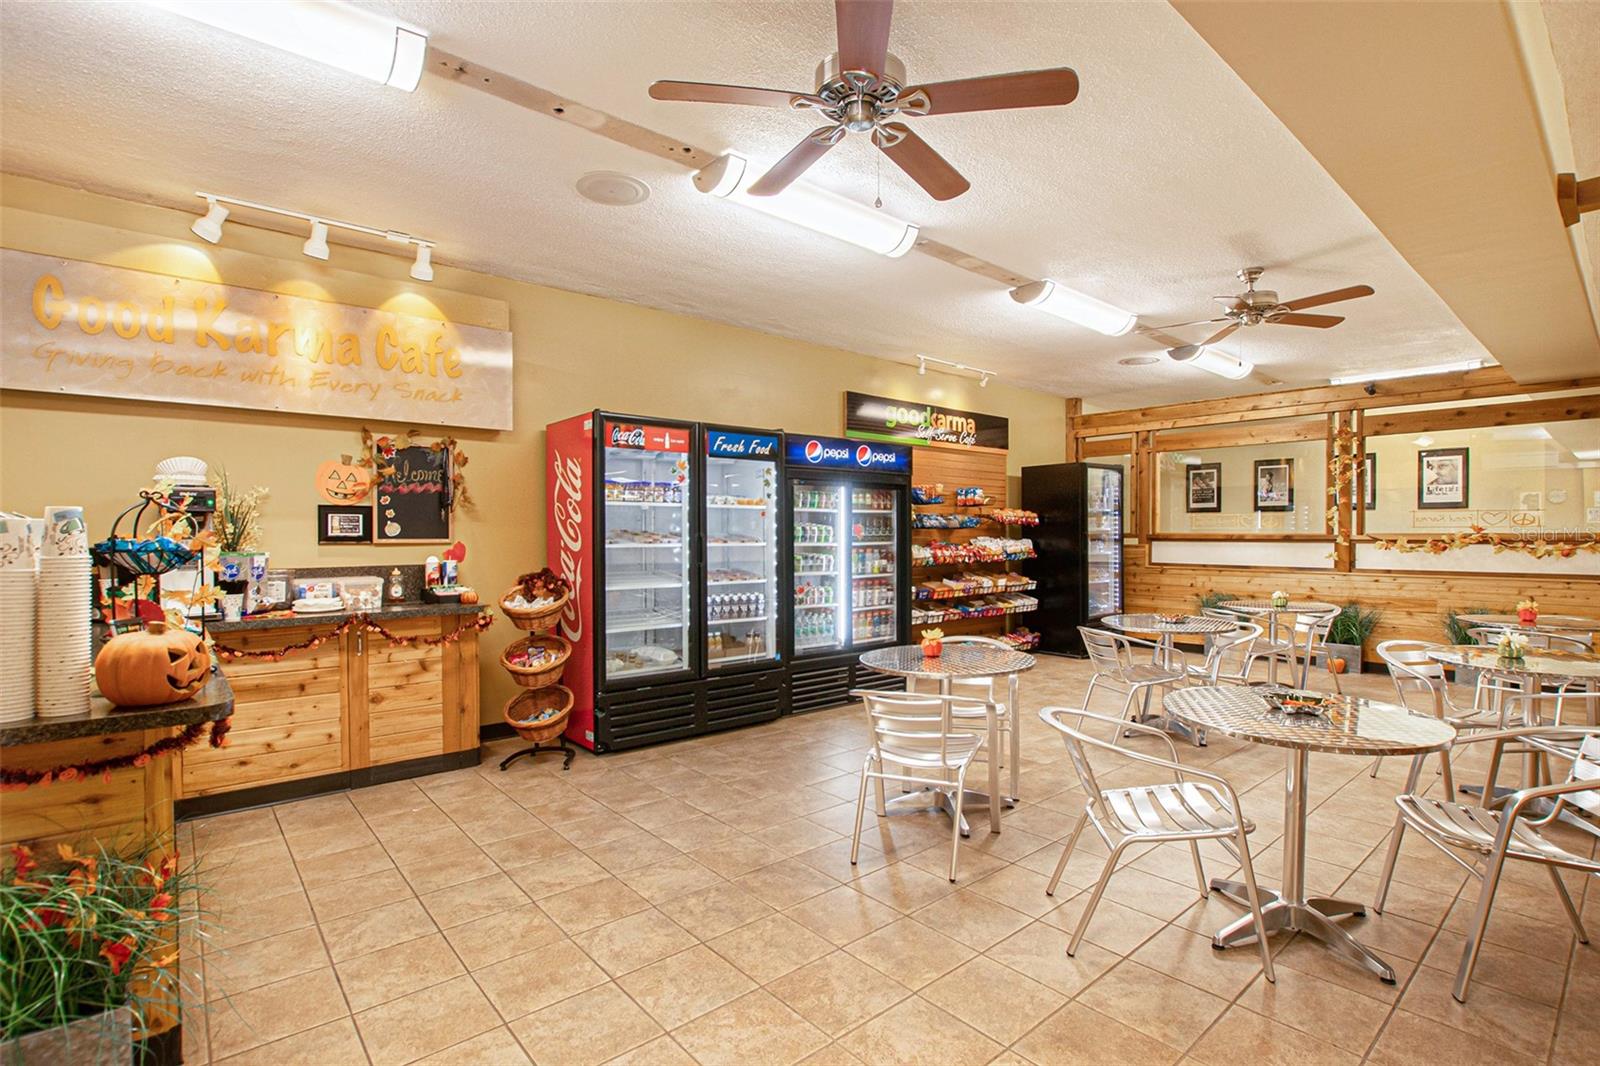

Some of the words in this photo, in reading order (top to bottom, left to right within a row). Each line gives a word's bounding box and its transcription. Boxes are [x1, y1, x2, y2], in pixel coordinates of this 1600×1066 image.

[32, 273, 174, 344] Good
[194, 297, 360, 367] Karma
[375, 324, 464, 378] Cafe
[31, 341, 134, 378] Giving
[150, 349, 226, 379] back
[240, 364, 297, 387] with
[310, 371, 381, 401] Every
[392, 382, 464, 403] Snack
[712, 435, 746, 455] Fresh
[751, 439, 772, 456] Food
[823, 445, 849, 461] pepsi
[871, 450, 896, 465] pepsi
